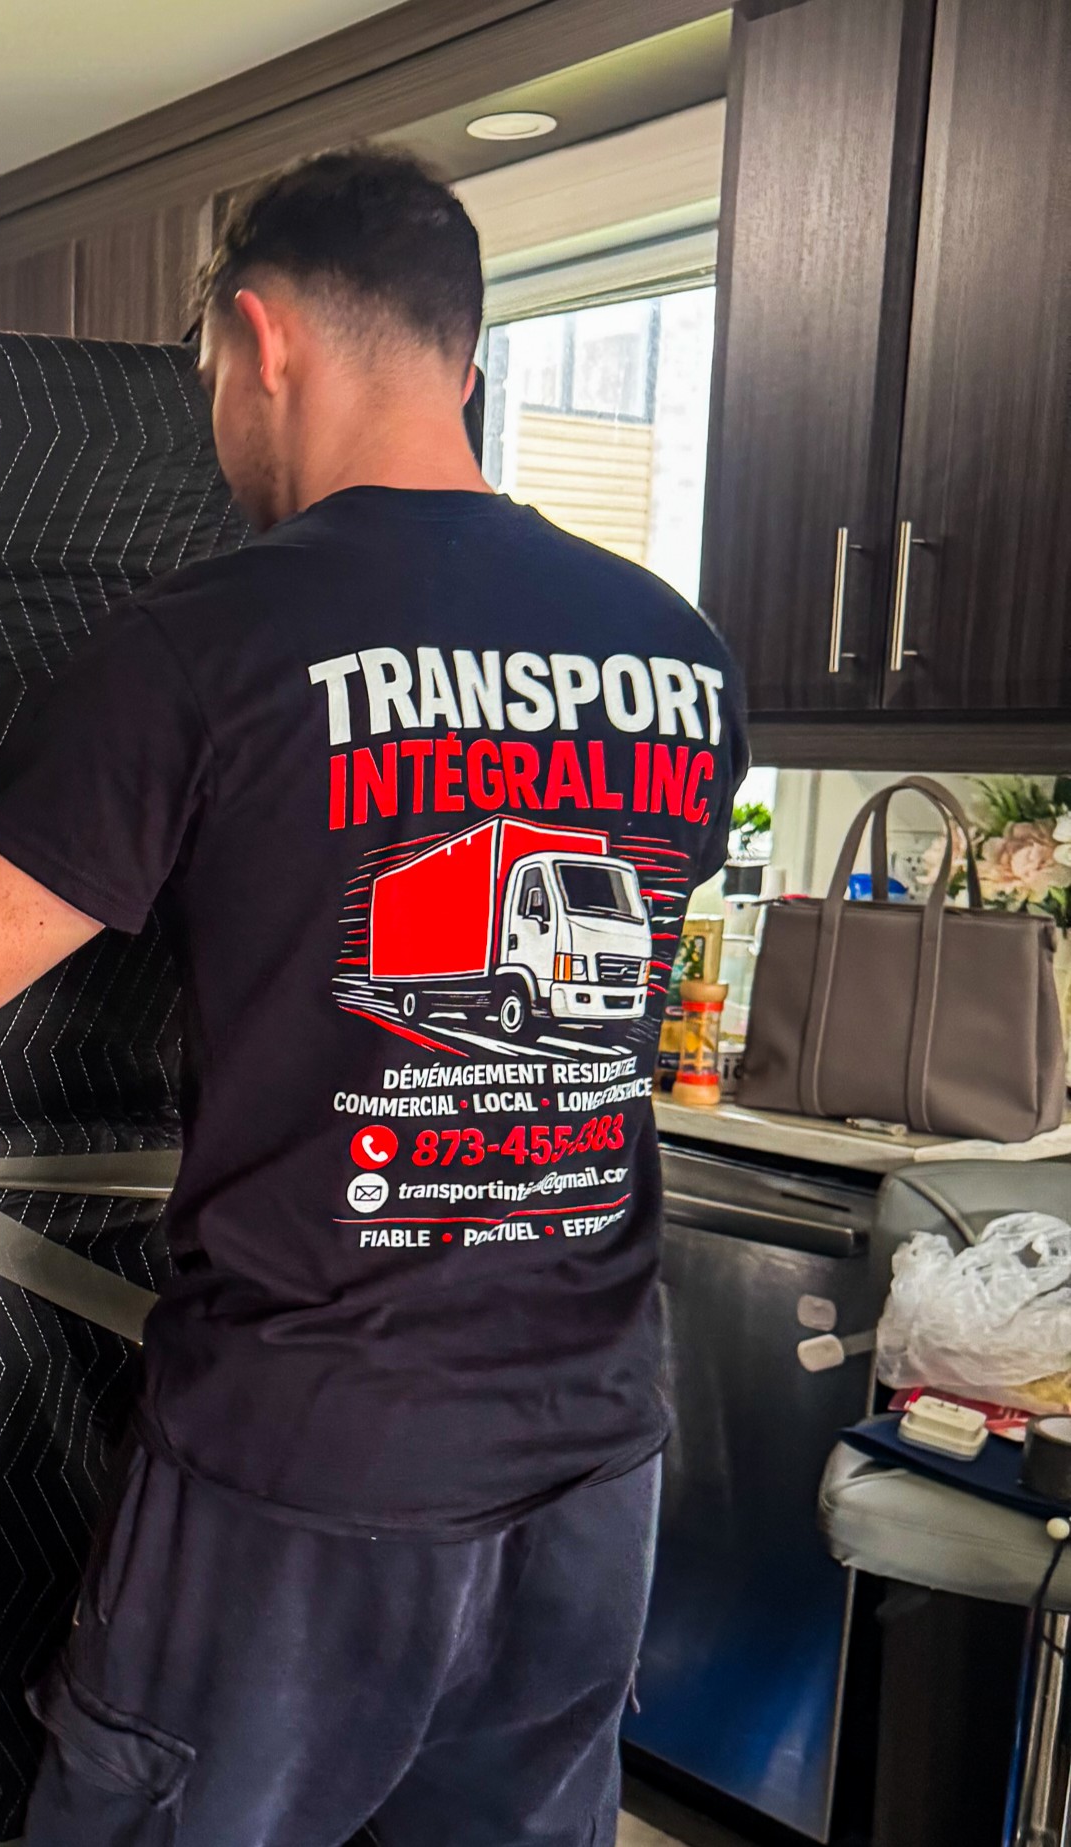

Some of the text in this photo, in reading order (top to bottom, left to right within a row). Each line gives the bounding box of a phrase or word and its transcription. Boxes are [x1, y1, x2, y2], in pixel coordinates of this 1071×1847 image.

[308, 646, 724, 746] TRANSPORT
[330, 731, 624, 830] INTÉGRAL
[383, 1063, 547, 1090] DÉMÉNAGEMENT
[333, 1091, 458, 1117] COMMERCIAL
[472, 1092, 538, 1113] LOCAL
[359, 1229, 431, 1248] FIABLE
